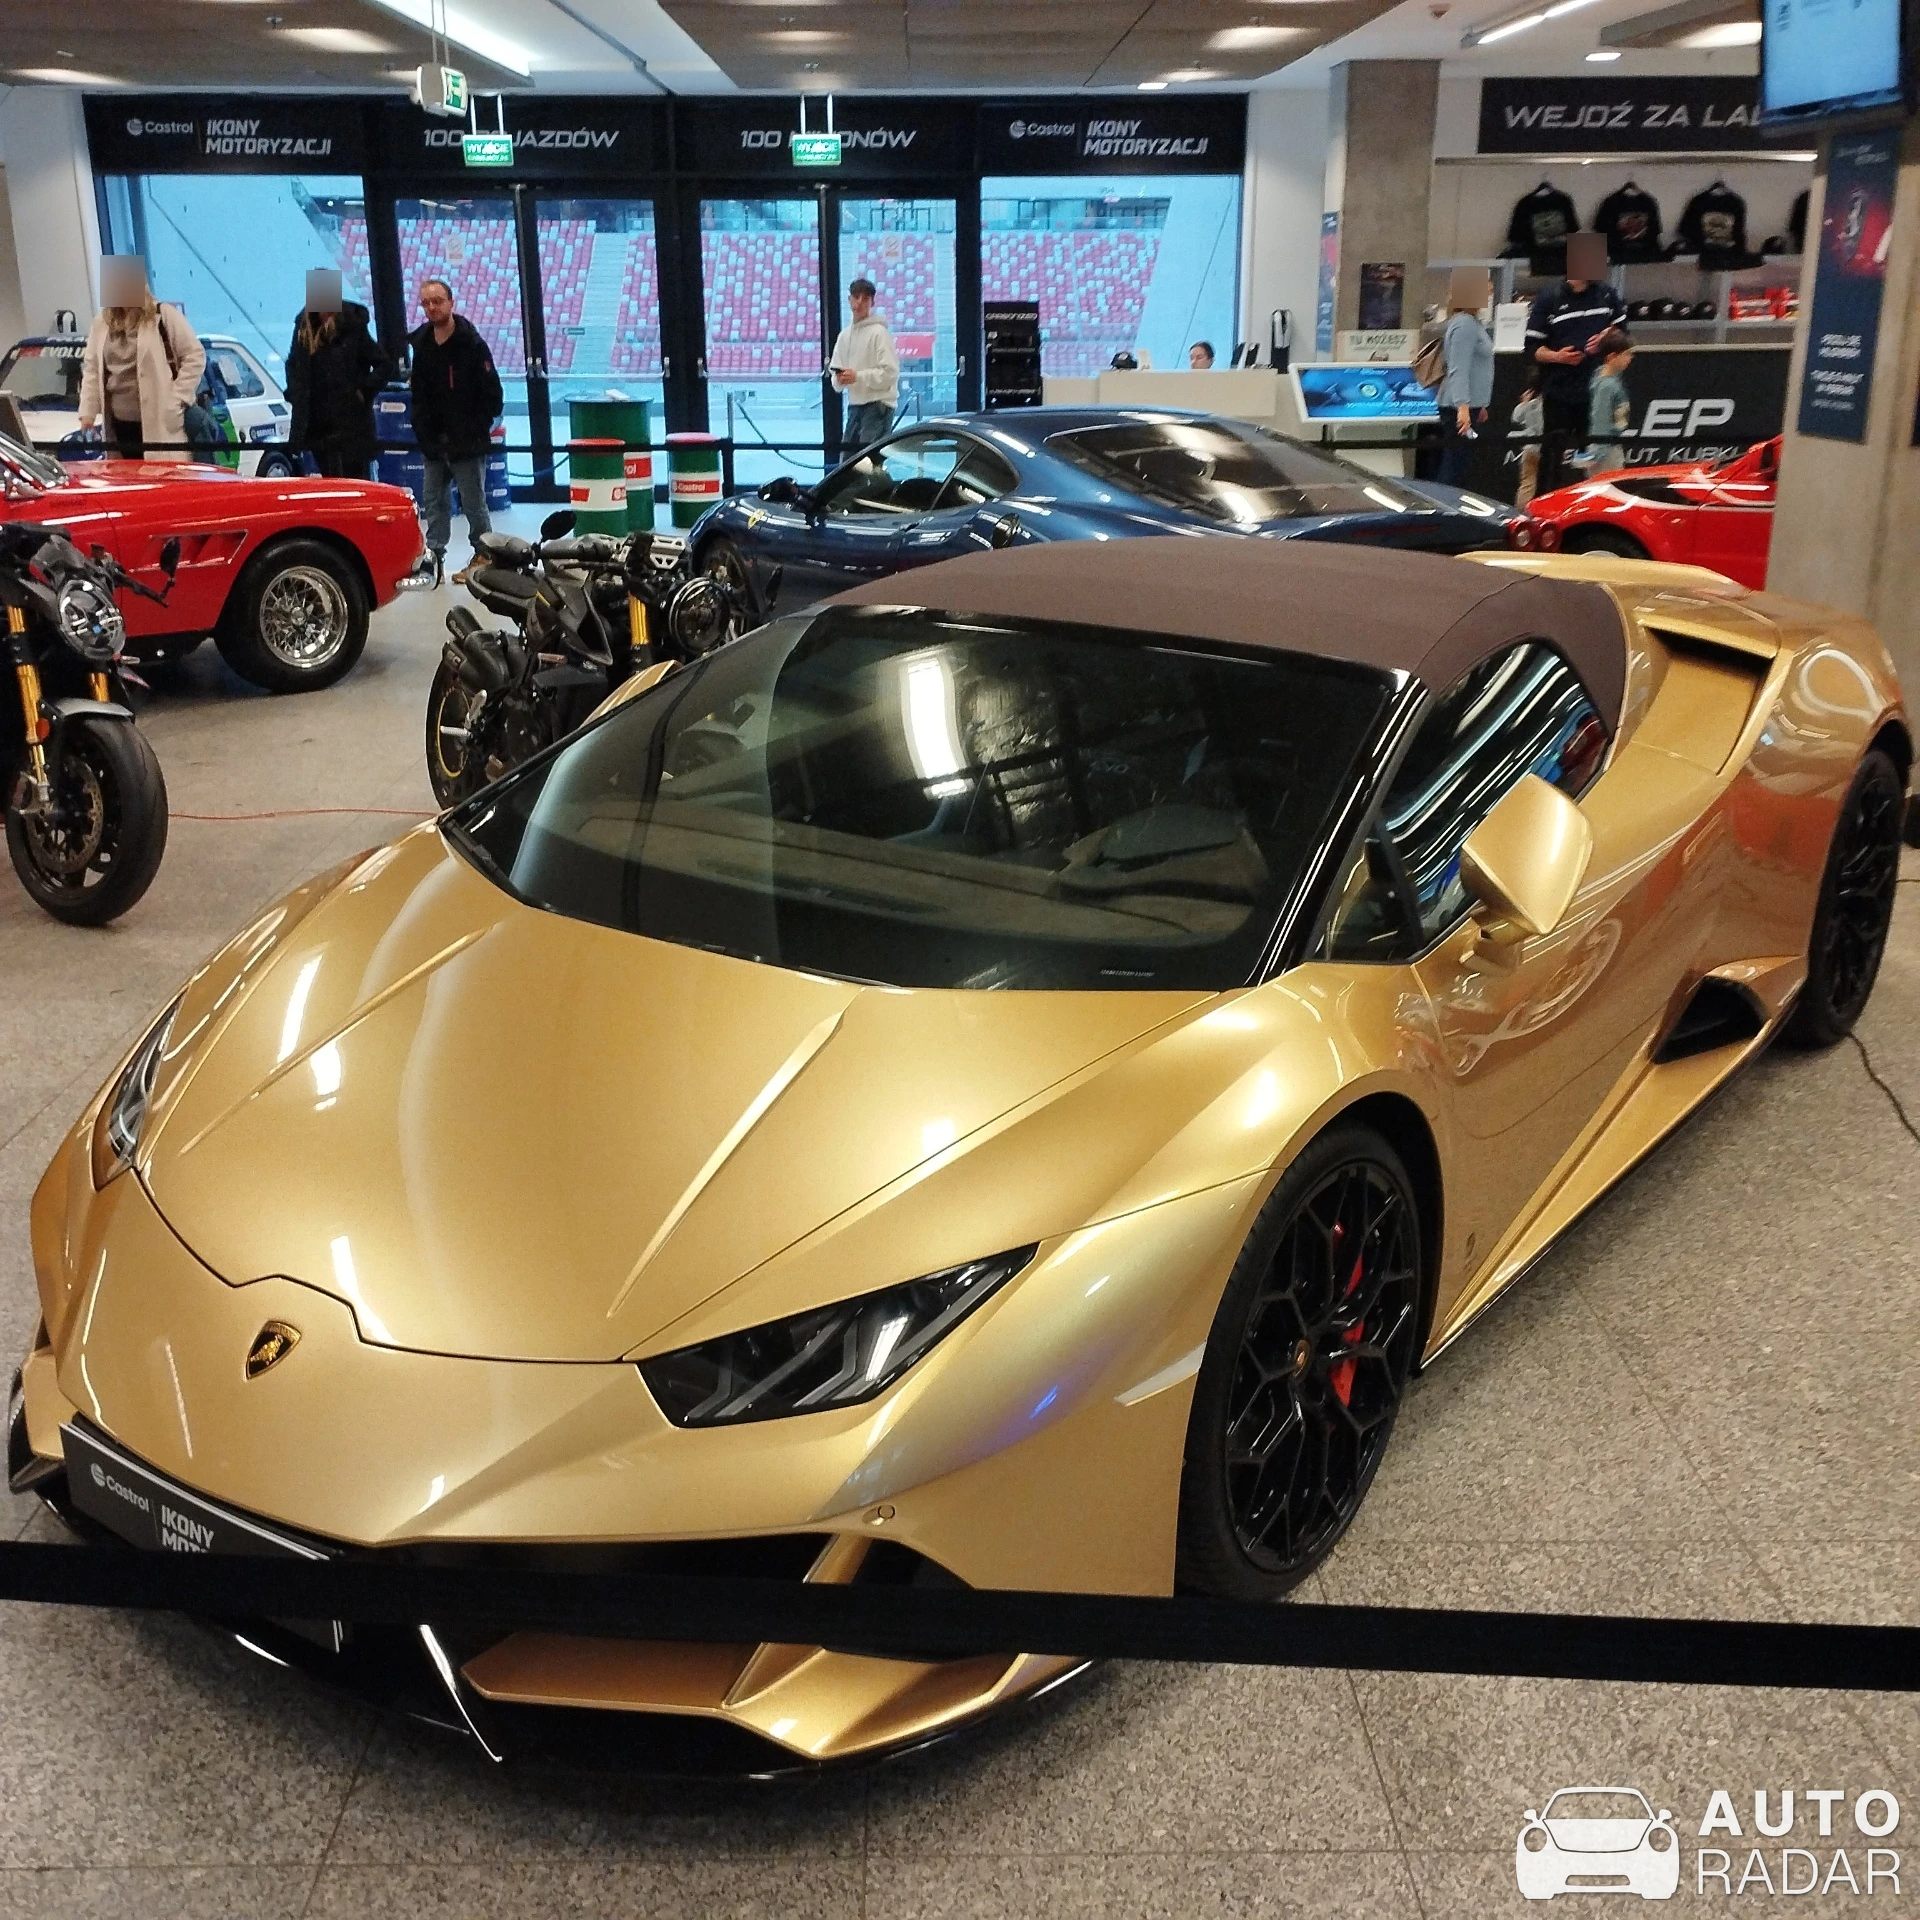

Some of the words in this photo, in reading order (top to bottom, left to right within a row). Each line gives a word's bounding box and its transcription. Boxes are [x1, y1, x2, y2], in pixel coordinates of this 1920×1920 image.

[1504, 100, 1634, 128] WEJDŹ
[1641, 104, 1691, 128] ZA
[145, 121, 194, 135] Castrol
[206, 119, 261, 136] IKONY
[1026, 122, 1075, 136] Castrol
[1087, 120, 1142, 137] IKONY
[205, 138, 332, 155] MOTORYZACJI
[423, 129, 465, 147] 100
[475, 127, 620, 148] JAZDÓW
[740, 130, 782, 148] 100
[1083, 138, 1209, 156] MOTORYZACJI
[106, 1475, 150, 1513] Castrol
[161, 1505, 214, 1549] IKONY
